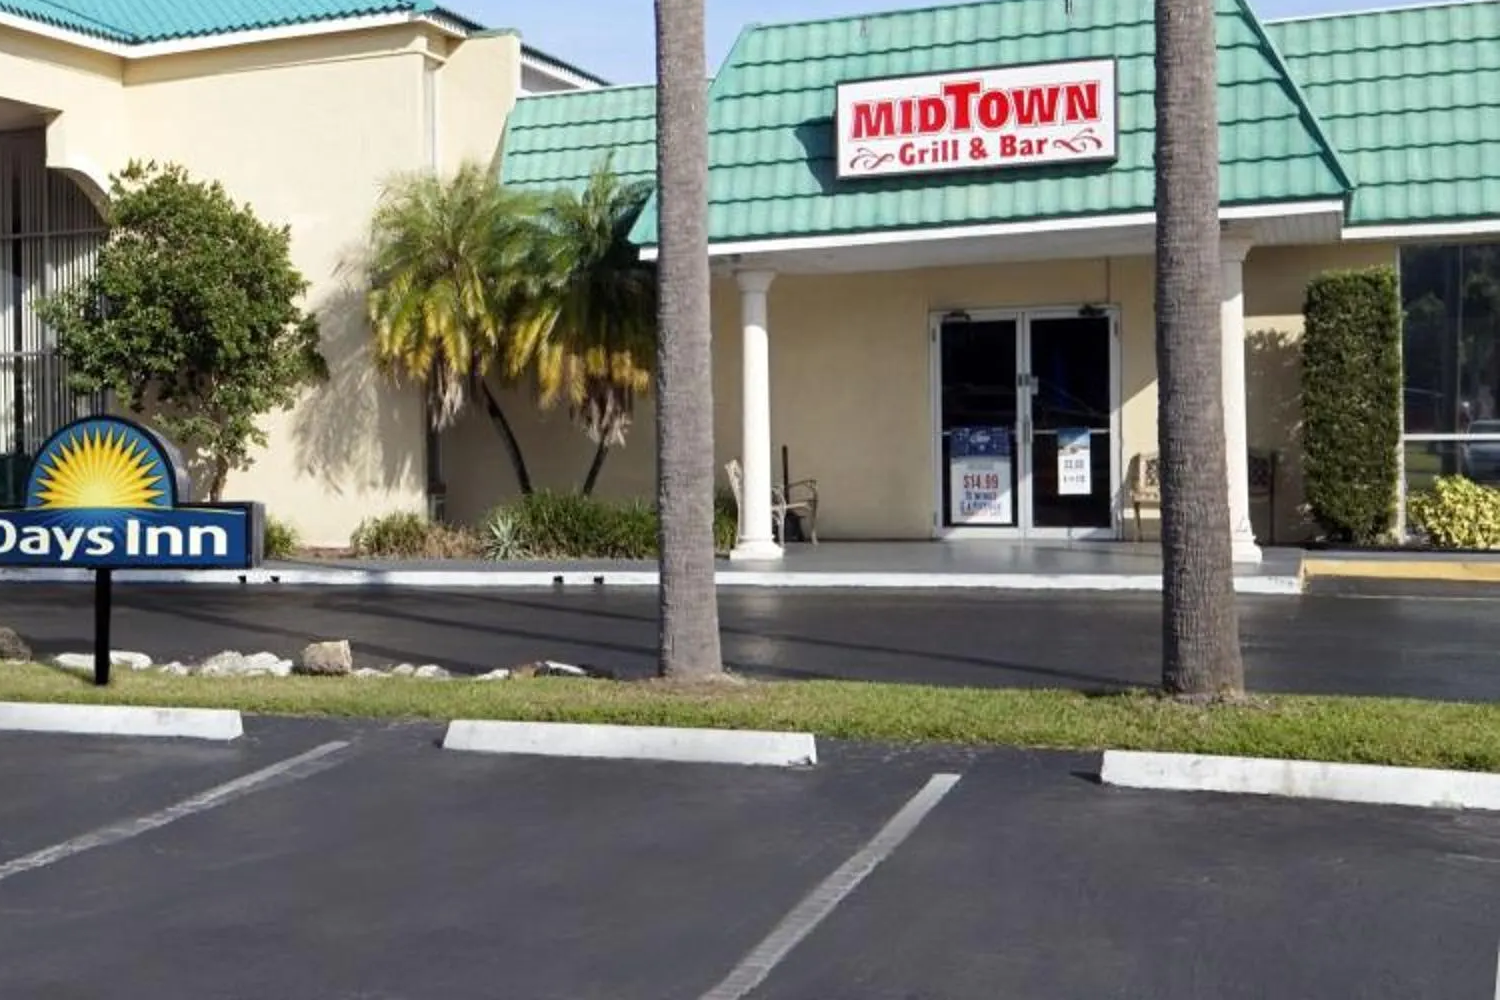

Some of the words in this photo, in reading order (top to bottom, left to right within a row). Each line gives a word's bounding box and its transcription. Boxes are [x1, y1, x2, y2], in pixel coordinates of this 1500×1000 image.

[851, 80, 1100, 139] MIDTOWN
[900, 139, 960, 166] Grill
[969, 136, 989, 161] &
[999, 133, 1049, 158] Bar
[126, 519, 228, 556] Inn
